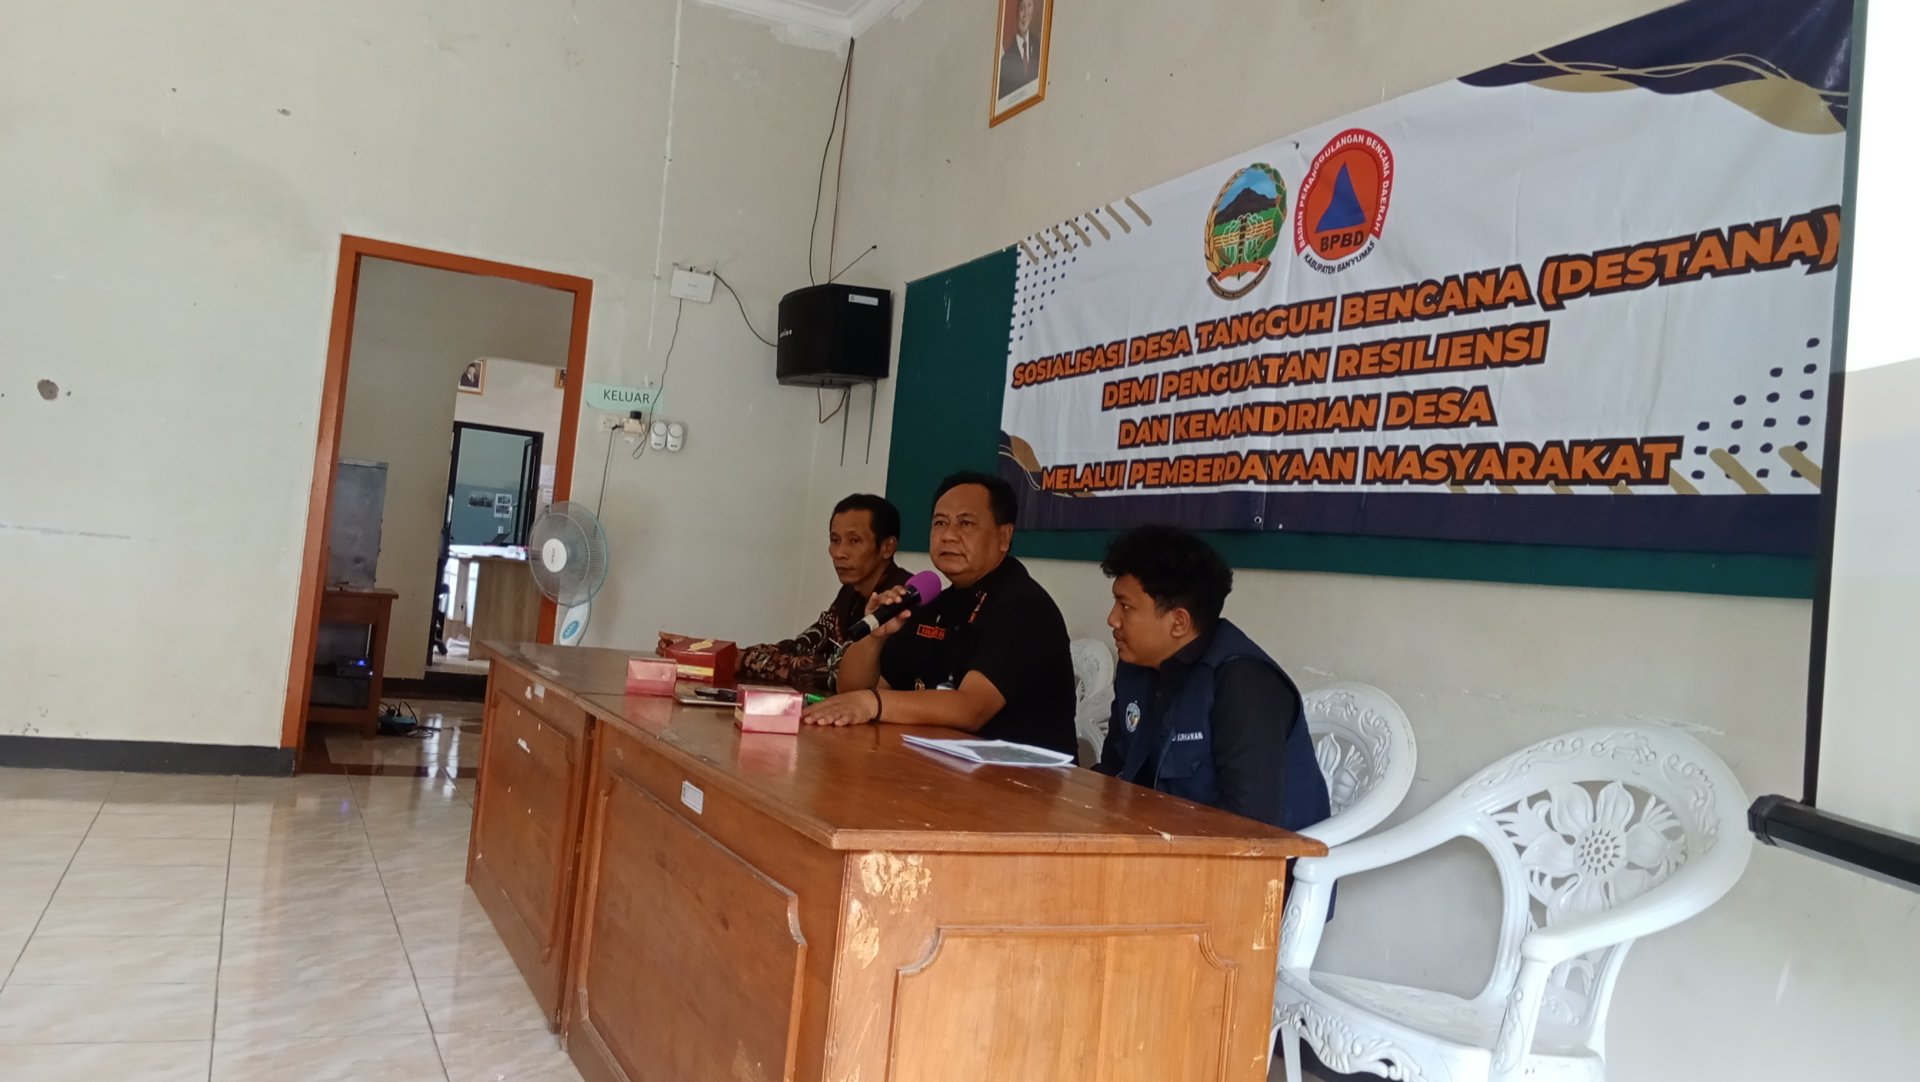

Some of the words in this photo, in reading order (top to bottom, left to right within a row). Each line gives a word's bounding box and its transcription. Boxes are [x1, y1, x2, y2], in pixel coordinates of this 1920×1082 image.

[1300, 133, 1365, 208] PENANGGULANGAN
[1366, 136, 1391, 179] BENCANA
[1296, 211, 1306, 249] BADAN
[1373, 180, 1390, 232] DAERAH
[1303, 252, 1336, 275] KABUPATEN
[1337, 240, 1376, 273] BANYUMAS
[1319, 230, 1365, 252] BPBD
[1011, 343, 1126, 389] SOSIALISASI
[1129, 325, 1192, 366] DESA
[1195, 297, 1336, 352] TANGGUH
[1339, 264, 1535, 332] BENCANA
[1537, 204, 1842, 311] (DESTANA)
[1101, 378, 1158, 412] DEMI
[1160, 350, 1329, 402] PENGUATAN
[1332, 319, 1550, 383] RESILIENSI
[603, 389, 650, 404] KELUAR
[1117, 416, 1171, 449] DAN
[1173, 397, 1382, 446] KEMANDIRIAN
[1386, 385, 1498, 430] DESA
[1040, 461, 1126, 493] MELALUI
[1128, 446, 1361, 488] PEMBERDAYAAN
[1363, 436, 1684, 486] MASYARAKAT
